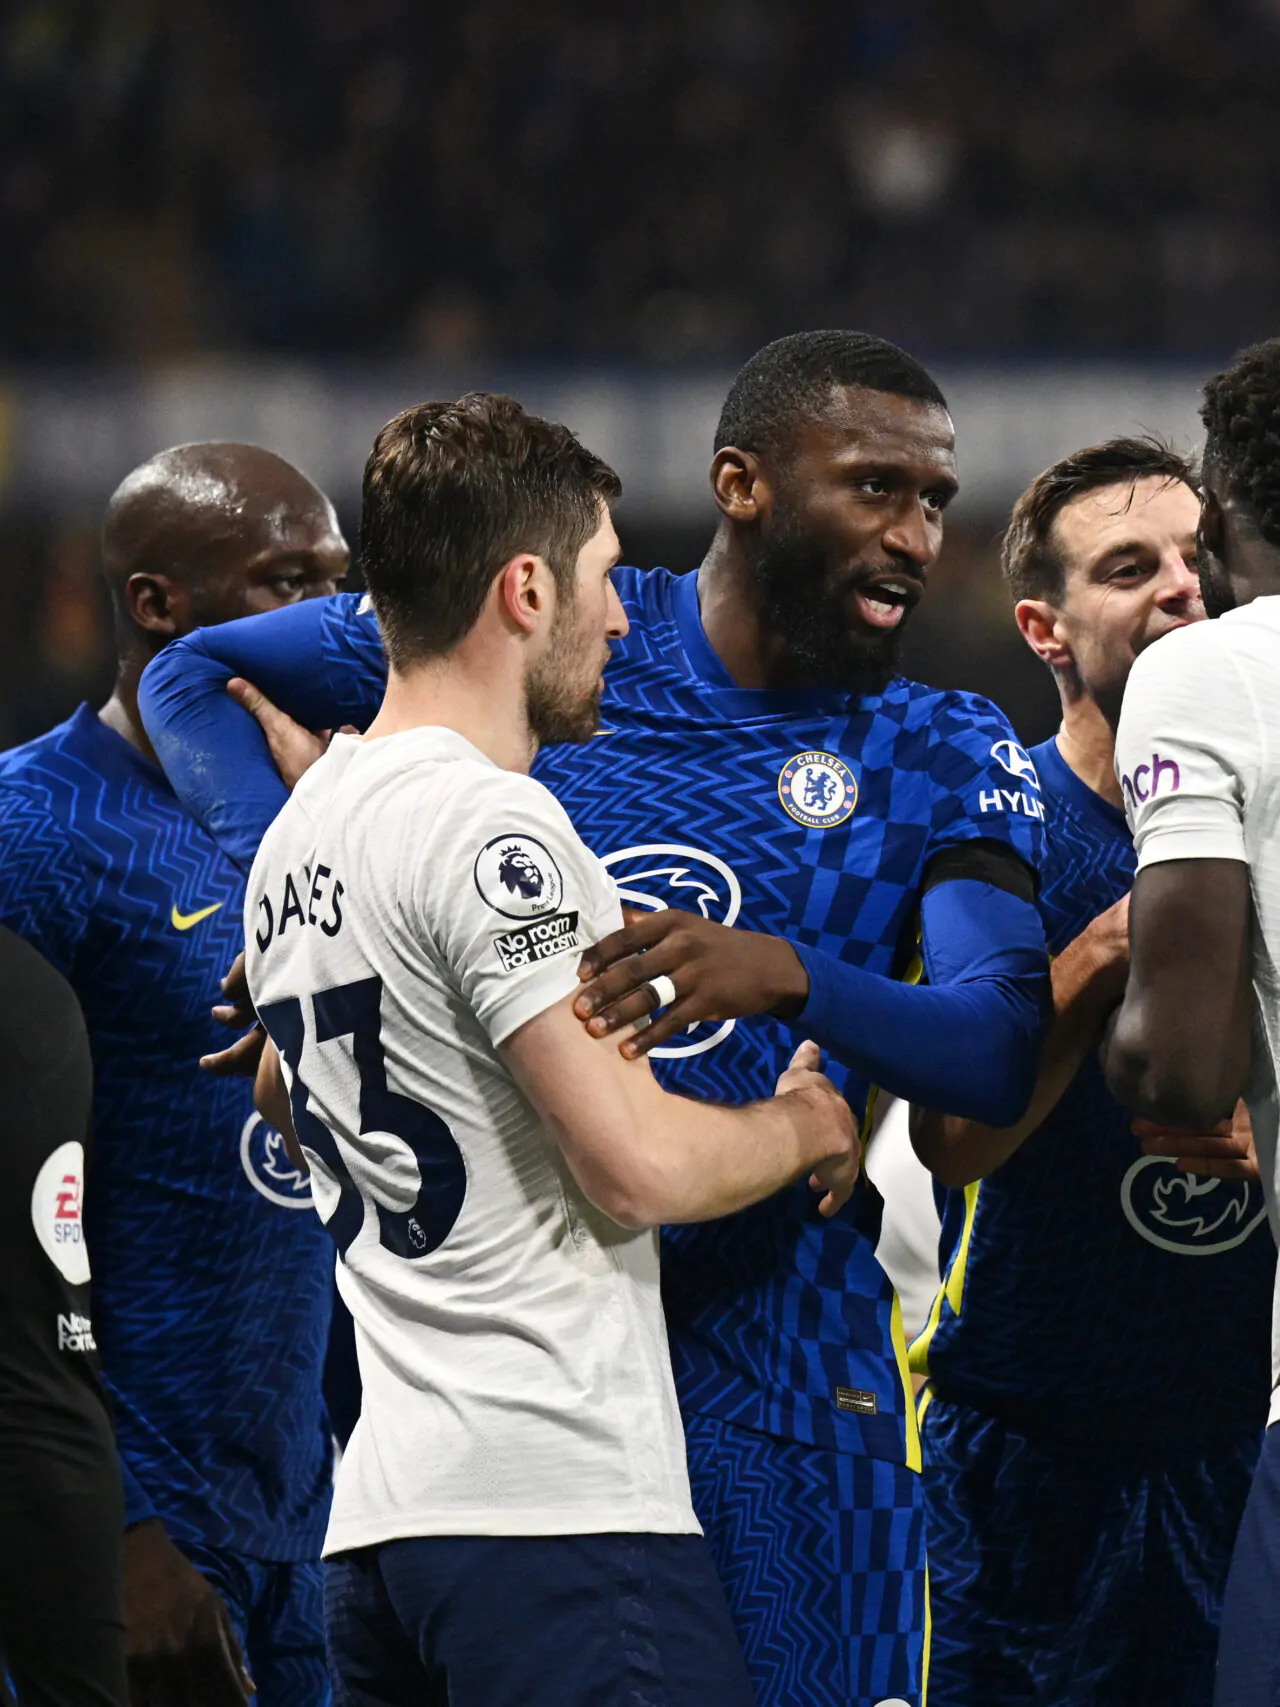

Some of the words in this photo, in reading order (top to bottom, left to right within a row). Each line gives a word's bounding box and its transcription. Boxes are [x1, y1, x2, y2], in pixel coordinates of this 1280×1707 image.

[797, 754, 847, 777] CHELSEA
[788, 803, 820, 824] FOOTBALL
[822, 814, 840, 824] CLUB
[494, 934, 528, 957] No
[528, 916, 570, 942] room
[534, 931, 579, 958] racism
[54, 1222, 84, 1244] SPO
